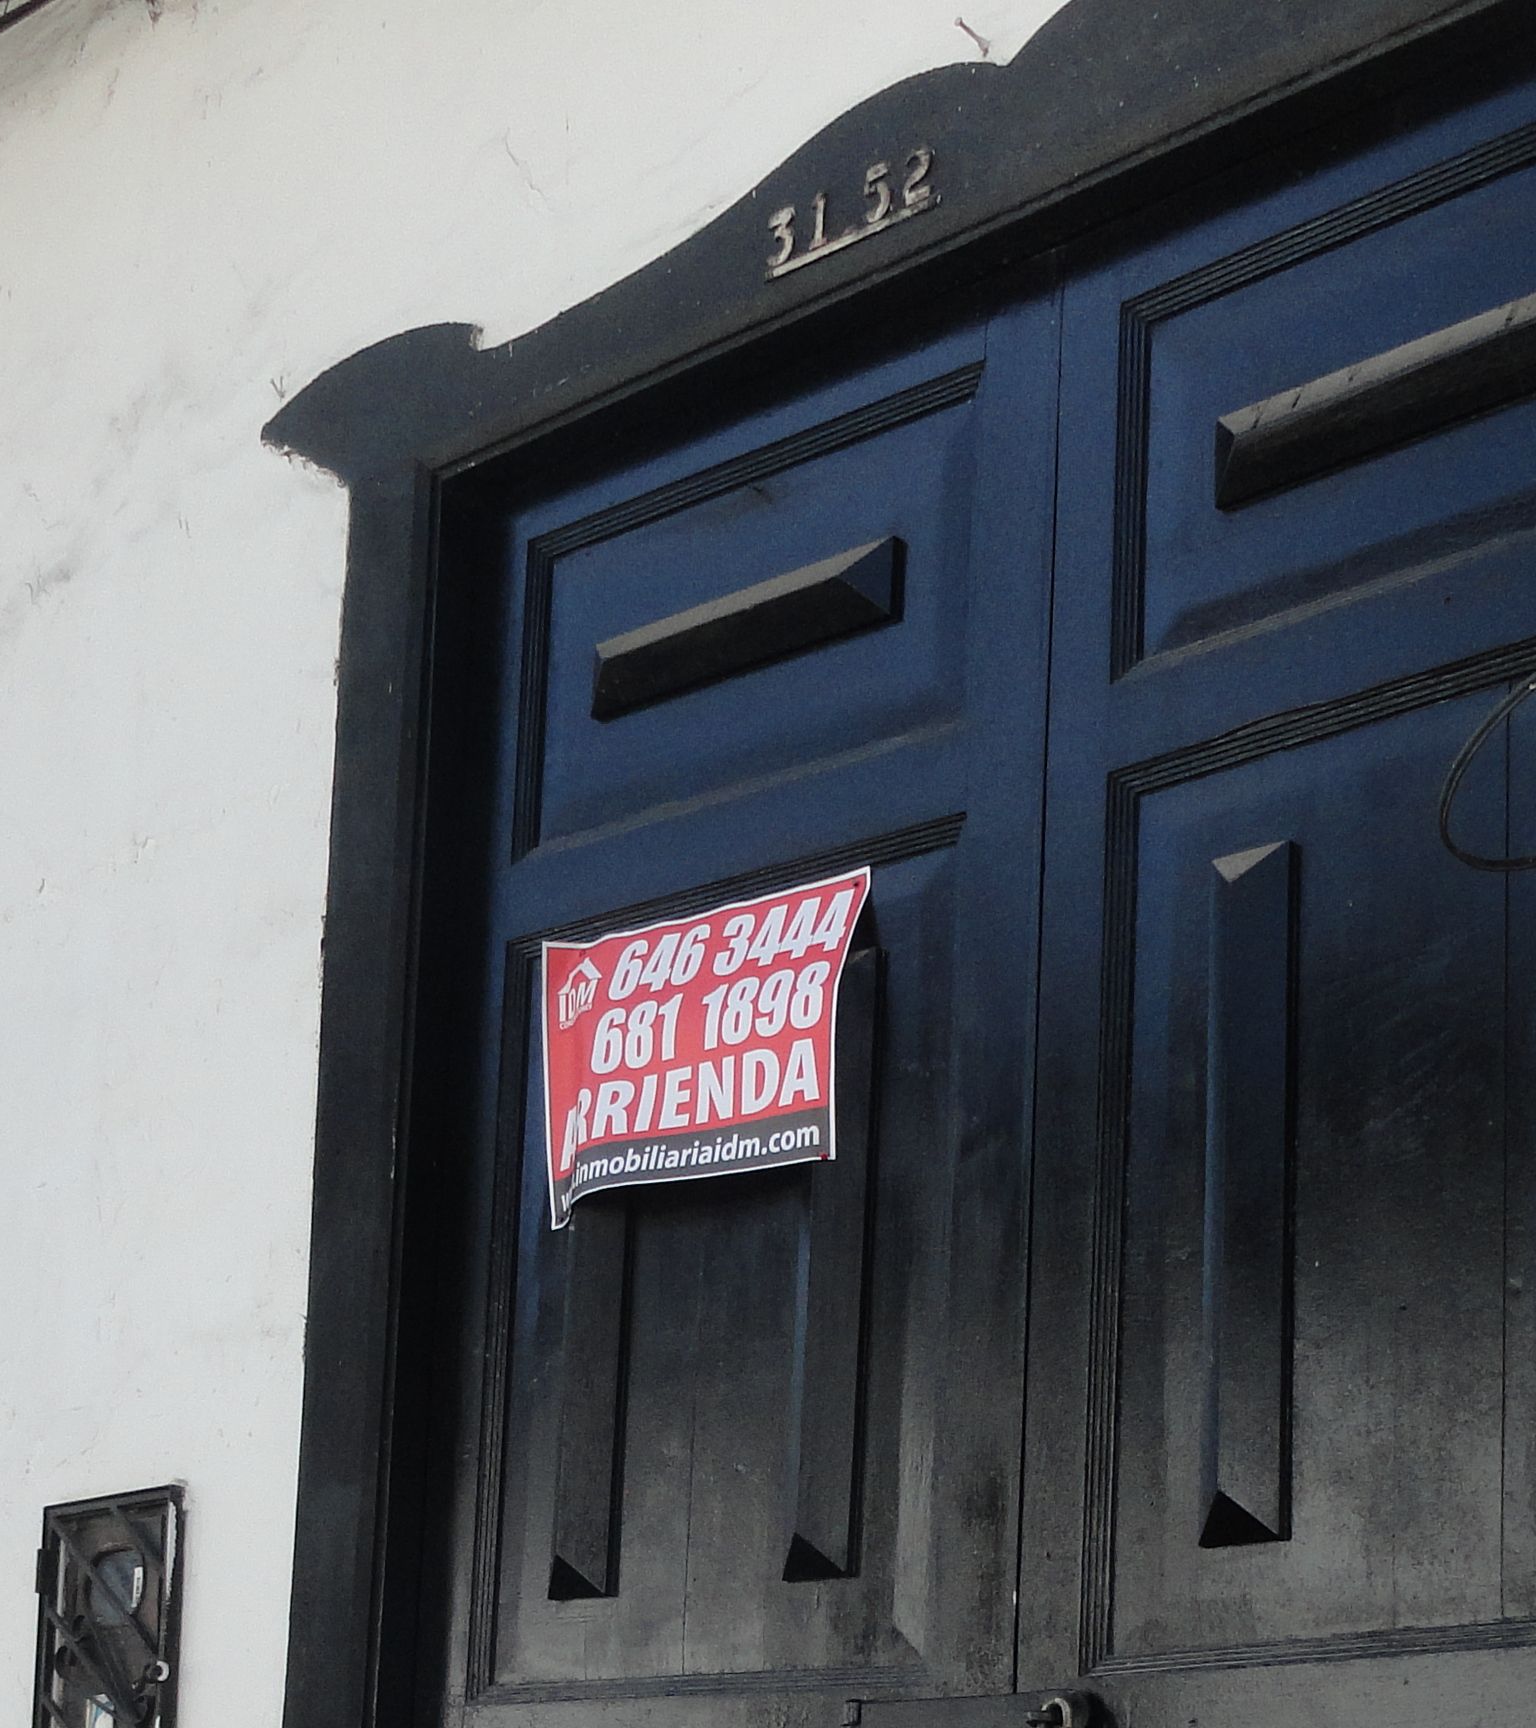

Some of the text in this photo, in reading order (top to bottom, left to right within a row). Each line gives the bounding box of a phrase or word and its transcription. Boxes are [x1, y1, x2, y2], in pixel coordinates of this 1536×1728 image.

[607, 888, 856, 1001] 646 3444
[590, 960, 831, 1075] 681 1898
